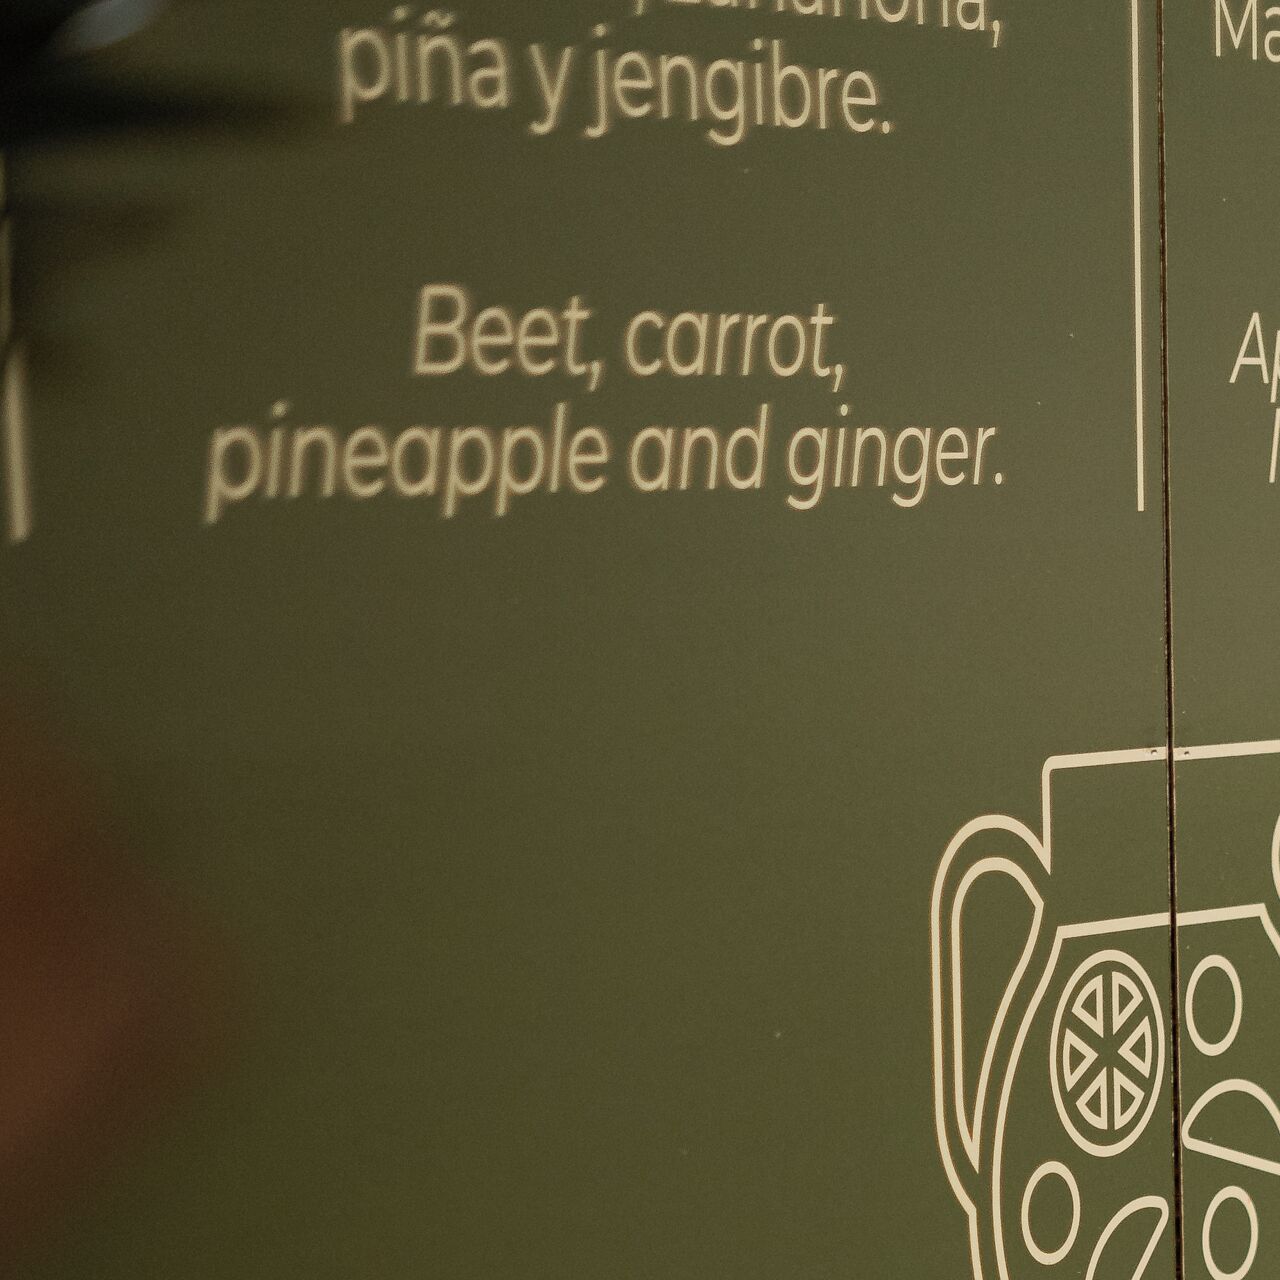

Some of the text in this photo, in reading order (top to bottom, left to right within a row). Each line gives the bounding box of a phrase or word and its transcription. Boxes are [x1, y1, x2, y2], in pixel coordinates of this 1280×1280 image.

[338, 6, 512, 122] piña
[529, 44, 574, 136] y
[584, 24, 893, 146] jengibre.
[413, 283, 845, 392] Beet, carrot,
[205, 401, 1004, 524] pineapple and ginger.
